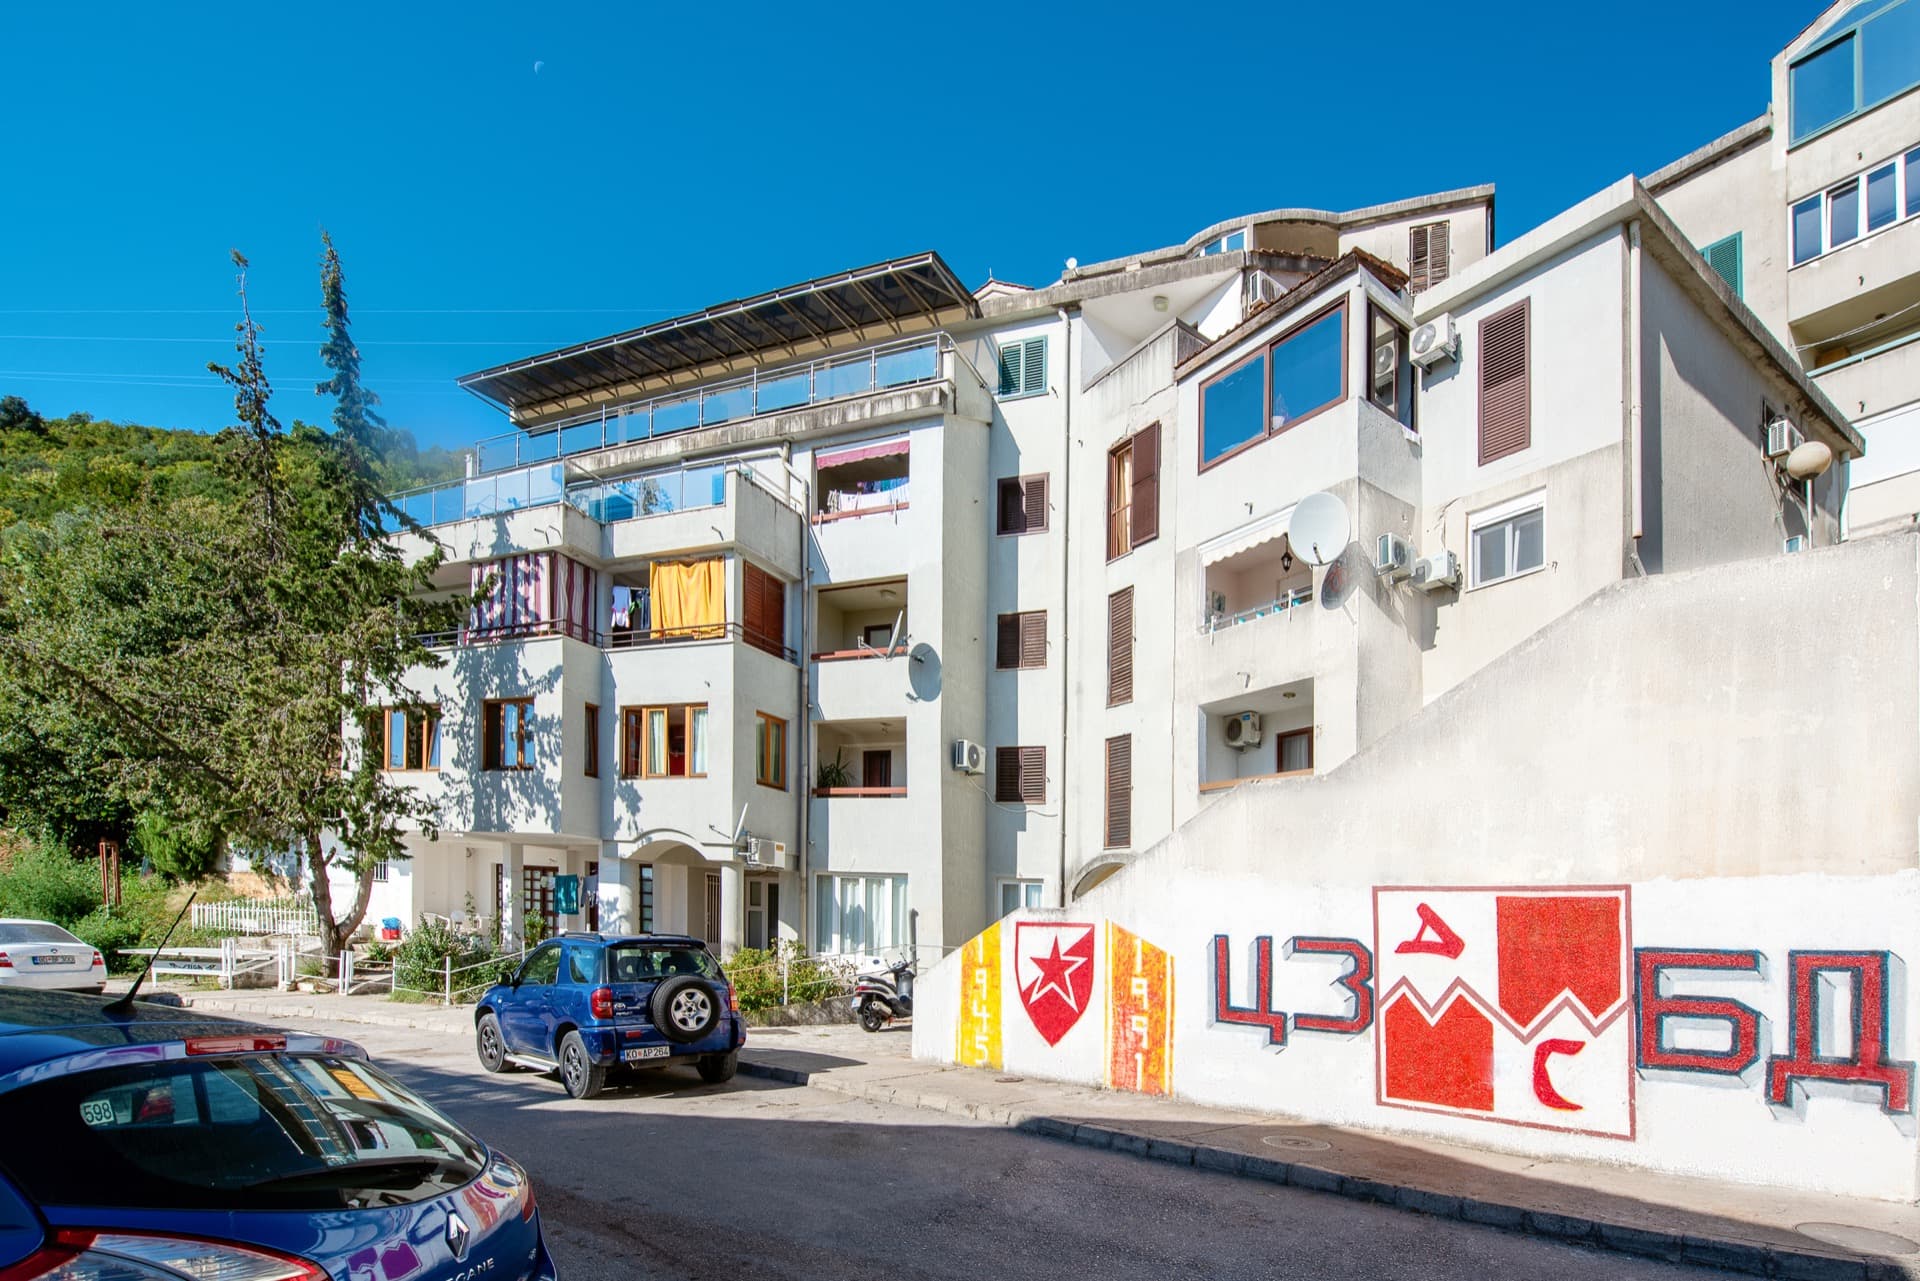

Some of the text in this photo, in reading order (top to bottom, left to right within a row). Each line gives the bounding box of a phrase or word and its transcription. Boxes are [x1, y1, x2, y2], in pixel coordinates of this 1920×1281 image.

[972, 934, 991, 1066] 1945
[1131, 938, 1149, 1092] 1991
[1209, 933, 1916, 1118] ЦЗ БД
[83, 1102, 112, 1123] 598
[446, 1257, 495, 1281] GANE
